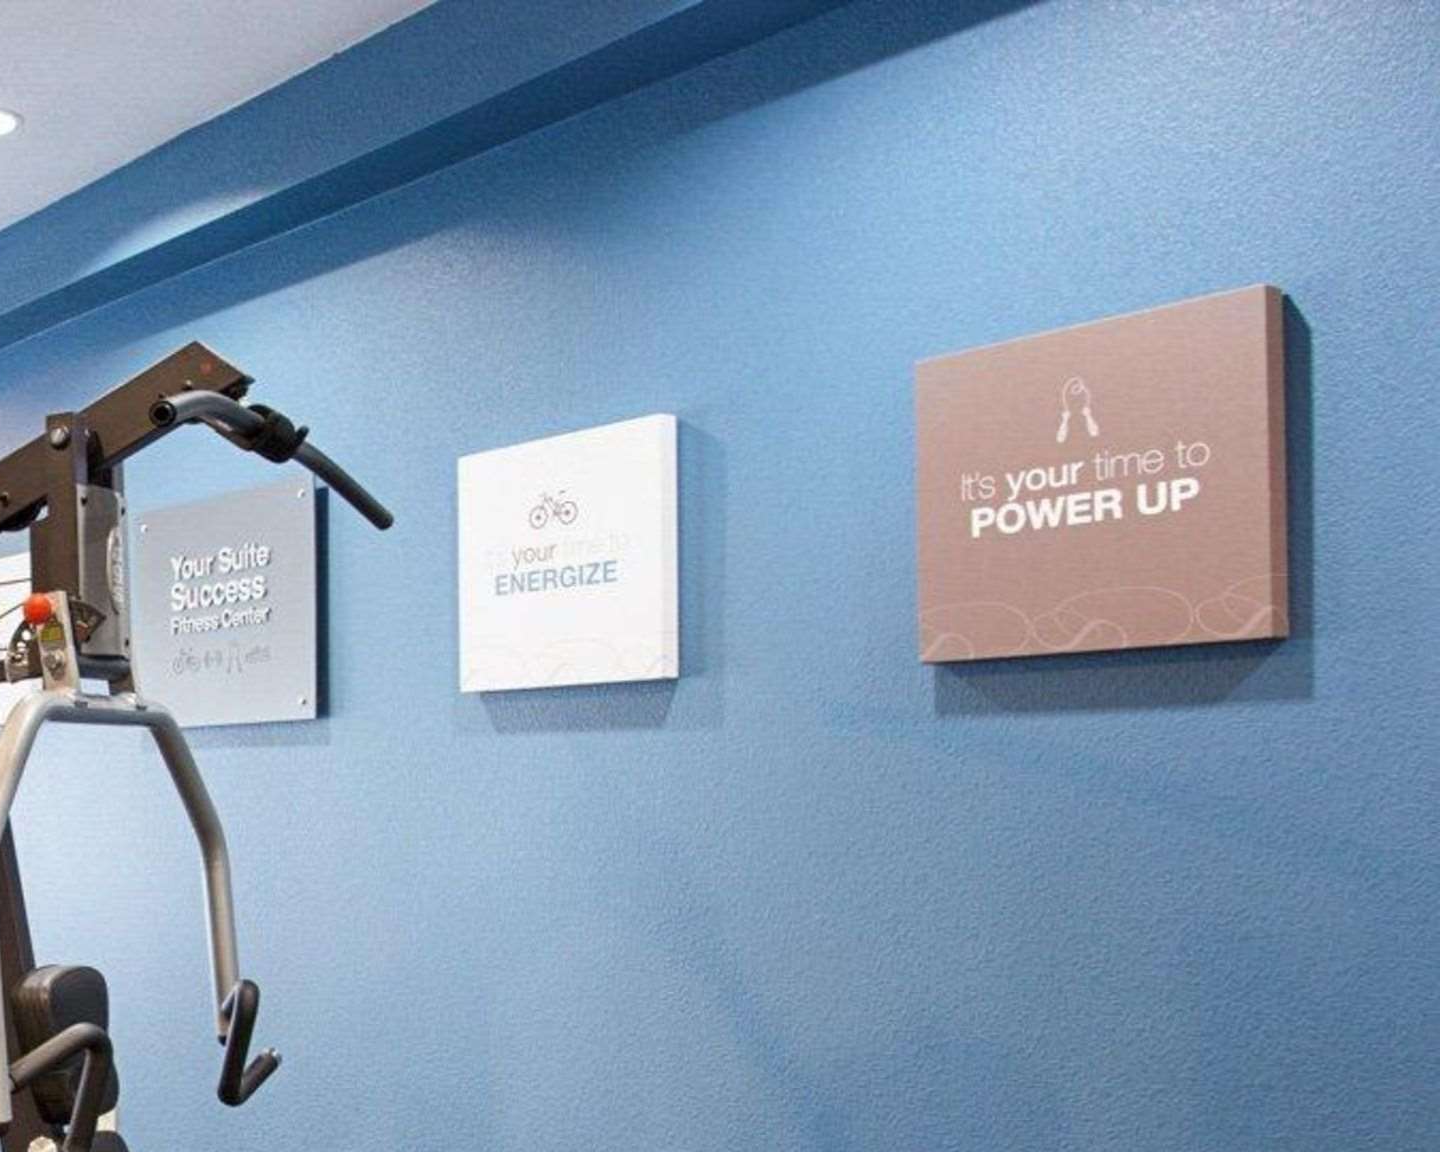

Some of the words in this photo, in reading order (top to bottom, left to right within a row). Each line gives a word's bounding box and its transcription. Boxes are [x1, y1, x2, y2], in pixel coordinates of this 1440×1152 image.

[960, 470, 995, 502] It's
[1005, 460, 1084, 500] your
[1094, 448, 1166, 482] time
[1176, 440, 1211, 470] to
[970, 486, 1123, 539] POWER
[1136, 476, 1200, 515] UP
[169, 554, 214, 582] Your
[217, 541, 271, 574] Suite
[511, 543, 558, 571] your
[170, 574, 268, 613] Success
[494, 559, 619, 597] ENERGIZE
[170, 611, 220, 636] Fitness
[221, 605, 272, 630] Center
